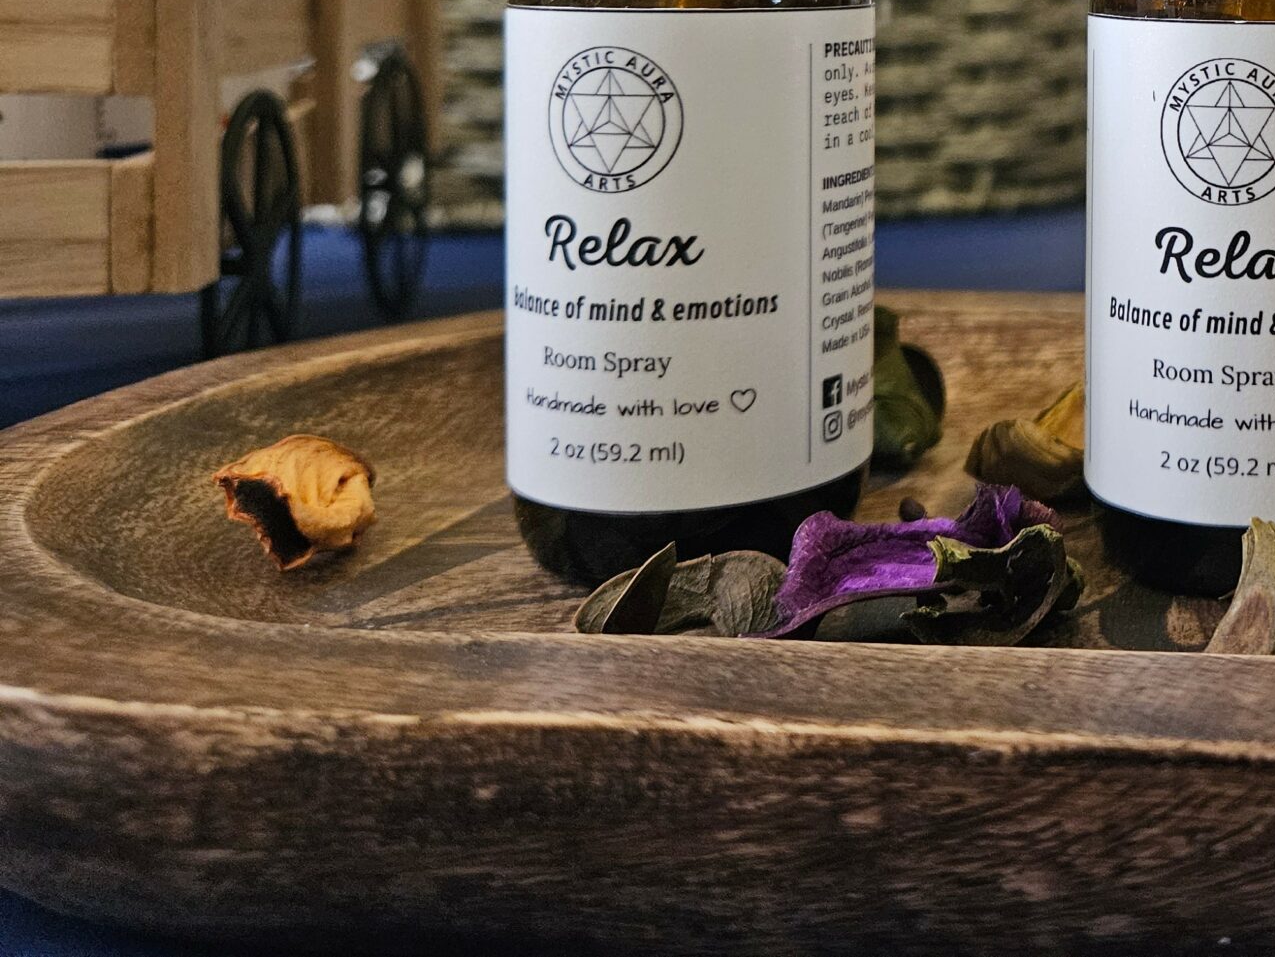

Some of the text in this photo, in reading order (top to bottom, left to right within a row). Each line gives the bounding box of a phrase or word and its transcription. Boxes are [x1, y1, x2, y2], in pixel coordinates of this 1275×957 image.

[554, 50, 675, 104] MYSTIC AURA
[1169, 62, 1235, 113] MYSTIC
[825, 89, 859, 106] eyes.
[825, 106, 859, 126] reach
[825, 133, 840, 149] in
[848, 133, 854, 146] a
[583, 173, 637, 191] ARTS
[1201, 185, 1256, 203] ARTS
[544, 214, 704, 271] Relax
[565, 296, 584, 320] of
[589, 296, 643, 322] mind
[652, 301, 665, 321] &
[673, 292, 779, 320] emotions
[823, 290, 848, 306] Grain
[1109, 297, 1173, 331] Balance
[1180, 308, 1202, 334] of
[1206, 310, 1262, 335] mind
[823, 335, 849, 353] Made
[544, 346, 672, 378] Room Spray
[1152, 359, 1213, 385] Room
[526, 388, 719, 417] Handmade with love
[1129, 399, 1224, 429] Handmade
[551, 438, 685, 463] 2 oz (59.2 ml)
[1160, 451, 1171, 469] 2
[1178, 457, 1199, 472] oz
[1206, 457, 1259, 478] (59.2
